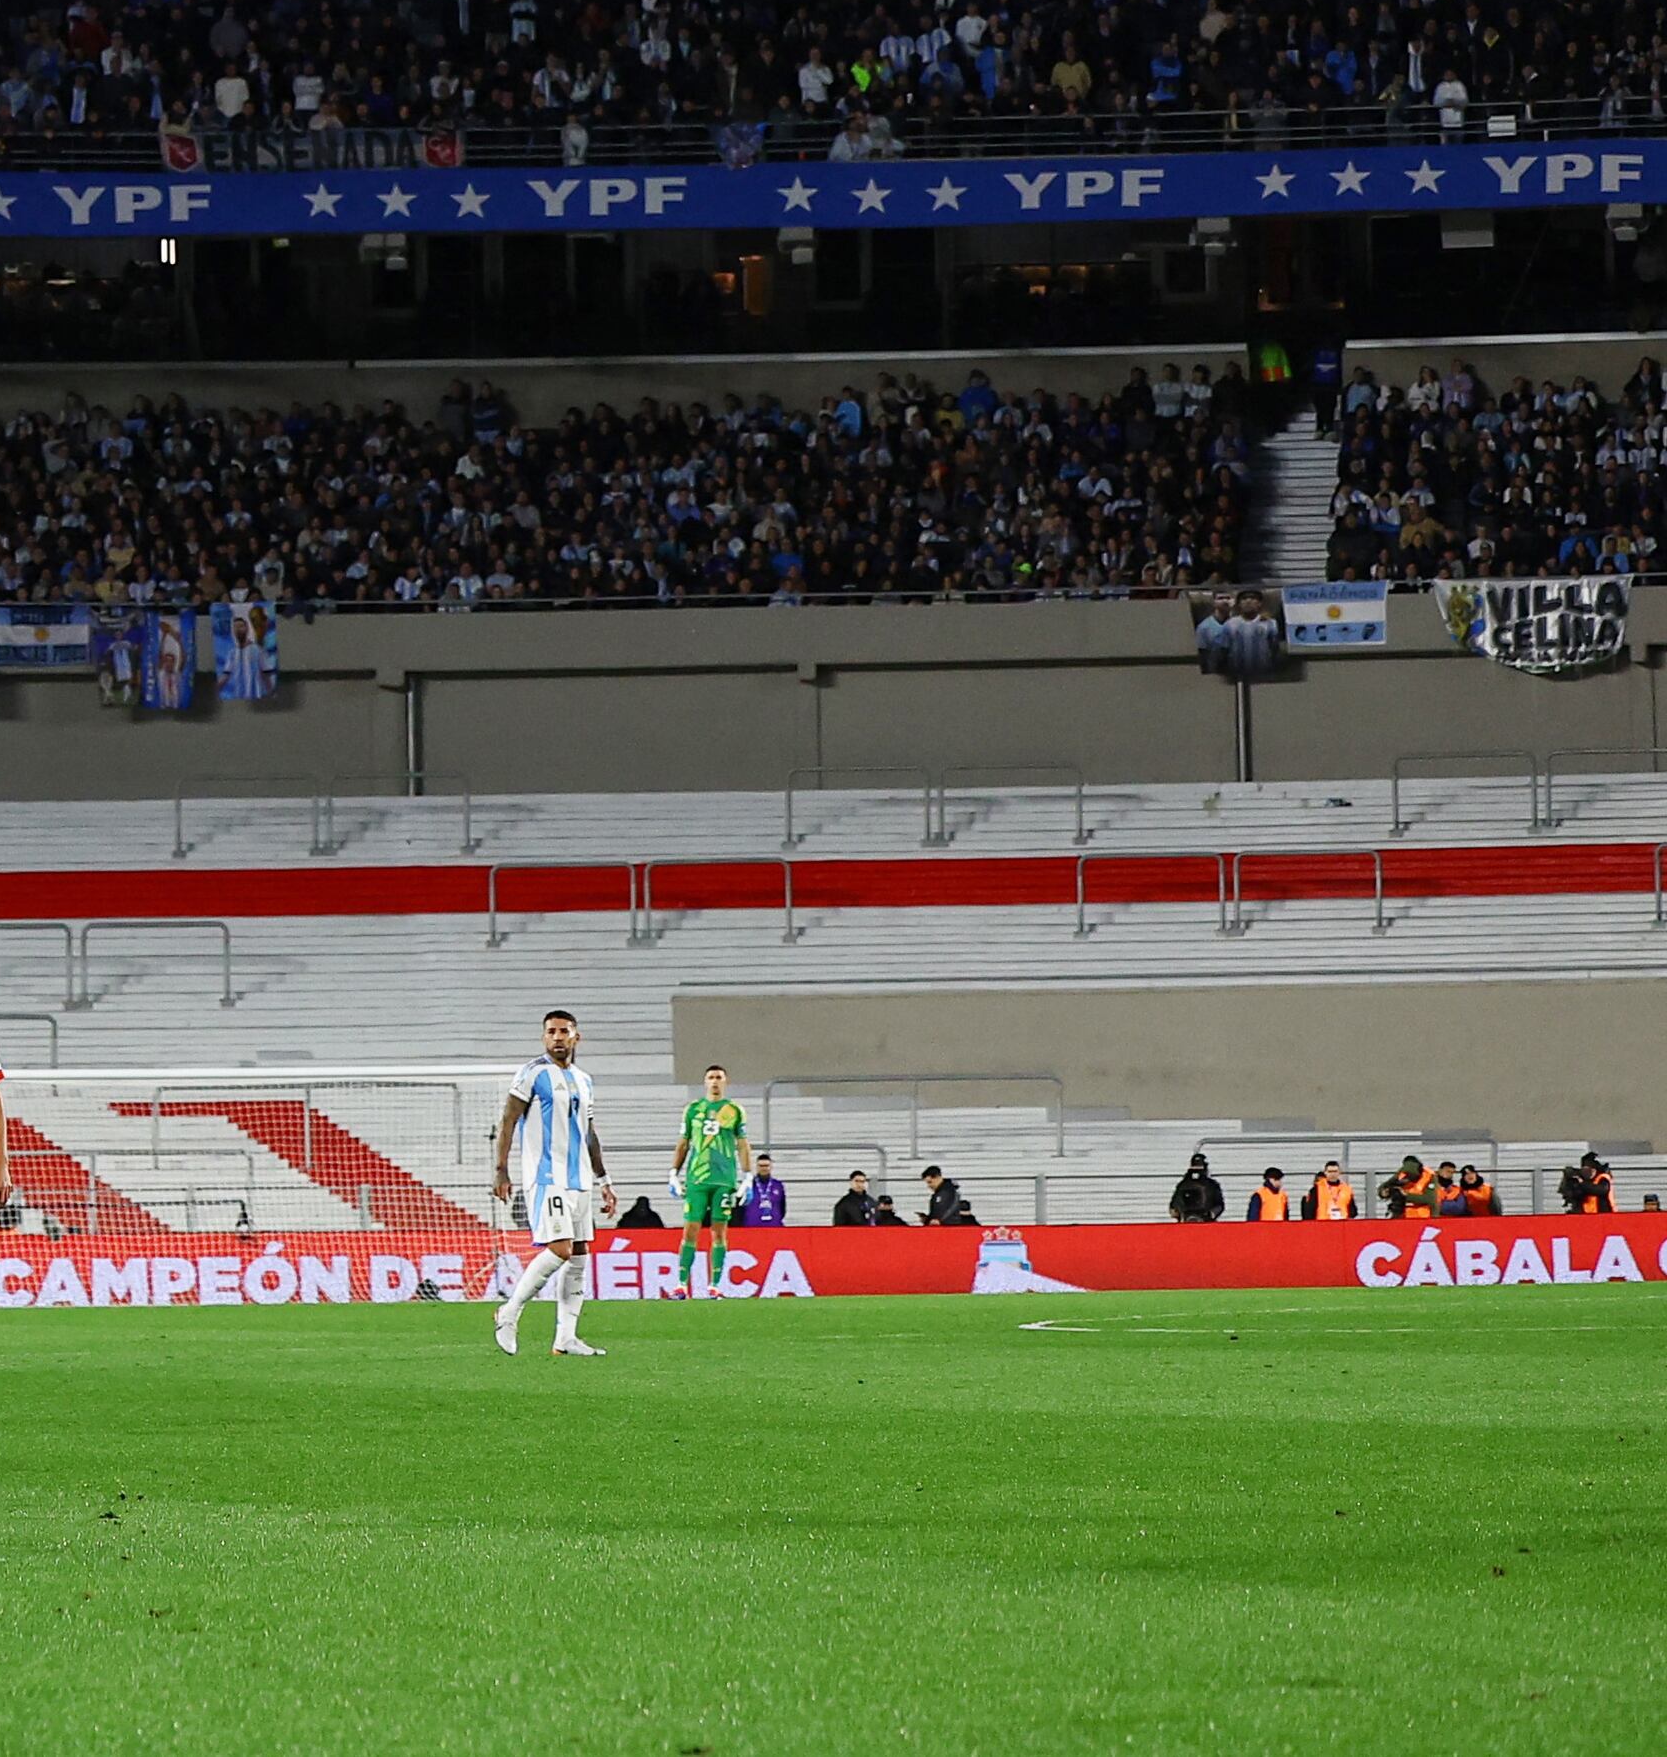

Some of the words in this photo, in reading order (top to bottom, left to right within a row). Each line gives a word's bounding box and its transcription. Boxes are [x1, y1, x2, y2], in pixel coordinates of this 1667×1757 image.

[53, 184, 212, 226] YPF
[526, 176, 687, 217] YPF
[1004, 168, 1165, 211] YPF
[1482, 153, 1644, 192] YPF
[1486, 582, 1629, 623] VILLA
[1492, 614, 1618, 650] CELINA
[702, 1118, 721, 1135] 23
[548, 1196, 564, 1217] 19
[370, 1255, 464, 1303] DE
[482, 1237, 815, 1302] AÉRICA
[1355, 1226, 1645, 1288] CÁBALA
